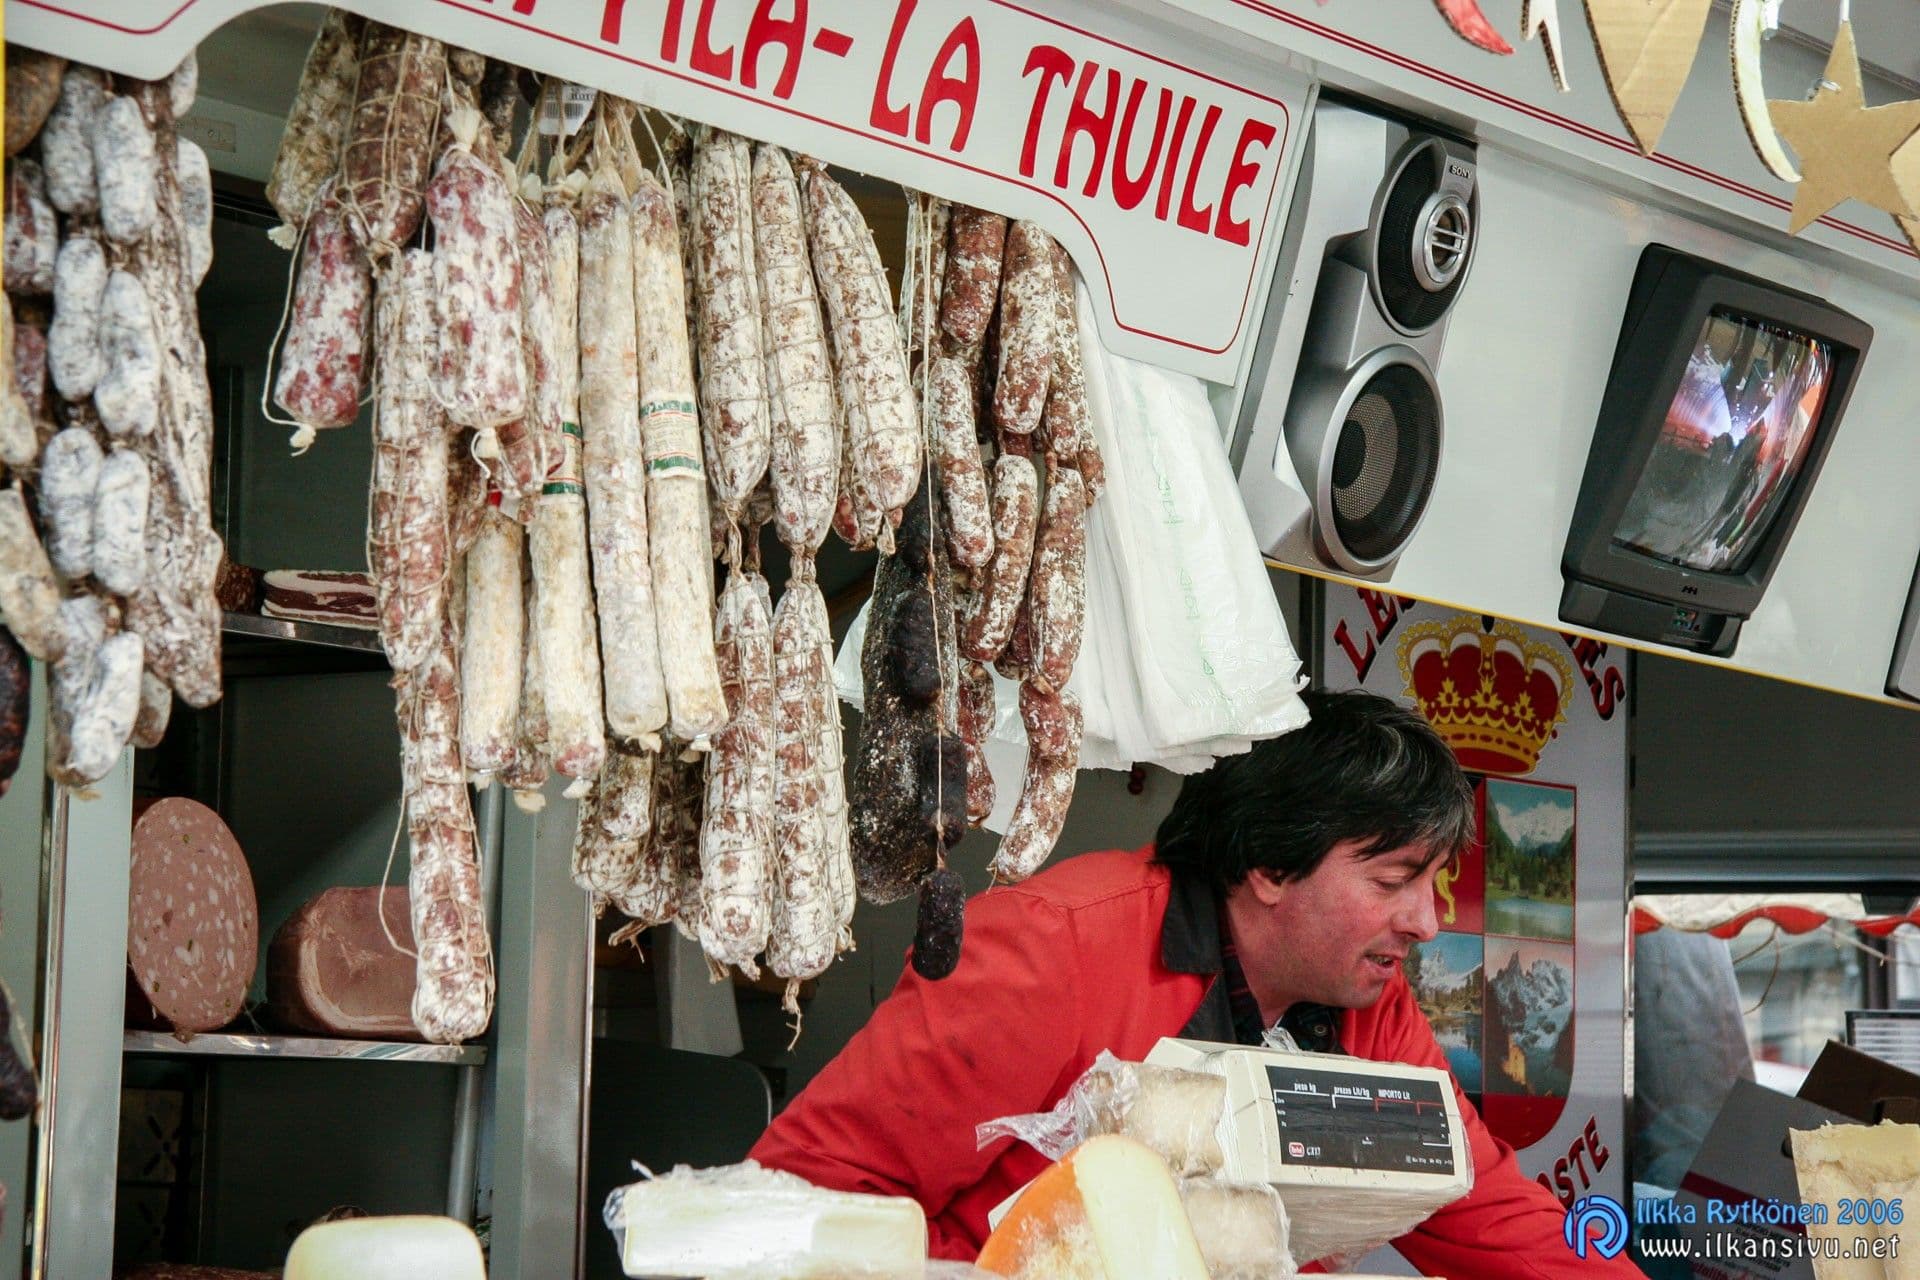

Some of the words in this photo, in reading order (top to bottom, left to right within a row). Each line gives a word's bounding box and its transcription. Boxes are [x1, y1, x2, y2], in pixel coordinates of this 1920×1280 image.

[868, 0, 981, 153] LA
[1018, 44, 1277, 248] THUILE
[1449, 165, 1473, 179] SONY
[1378, 1088, 1402, 1099] IMPORTO
